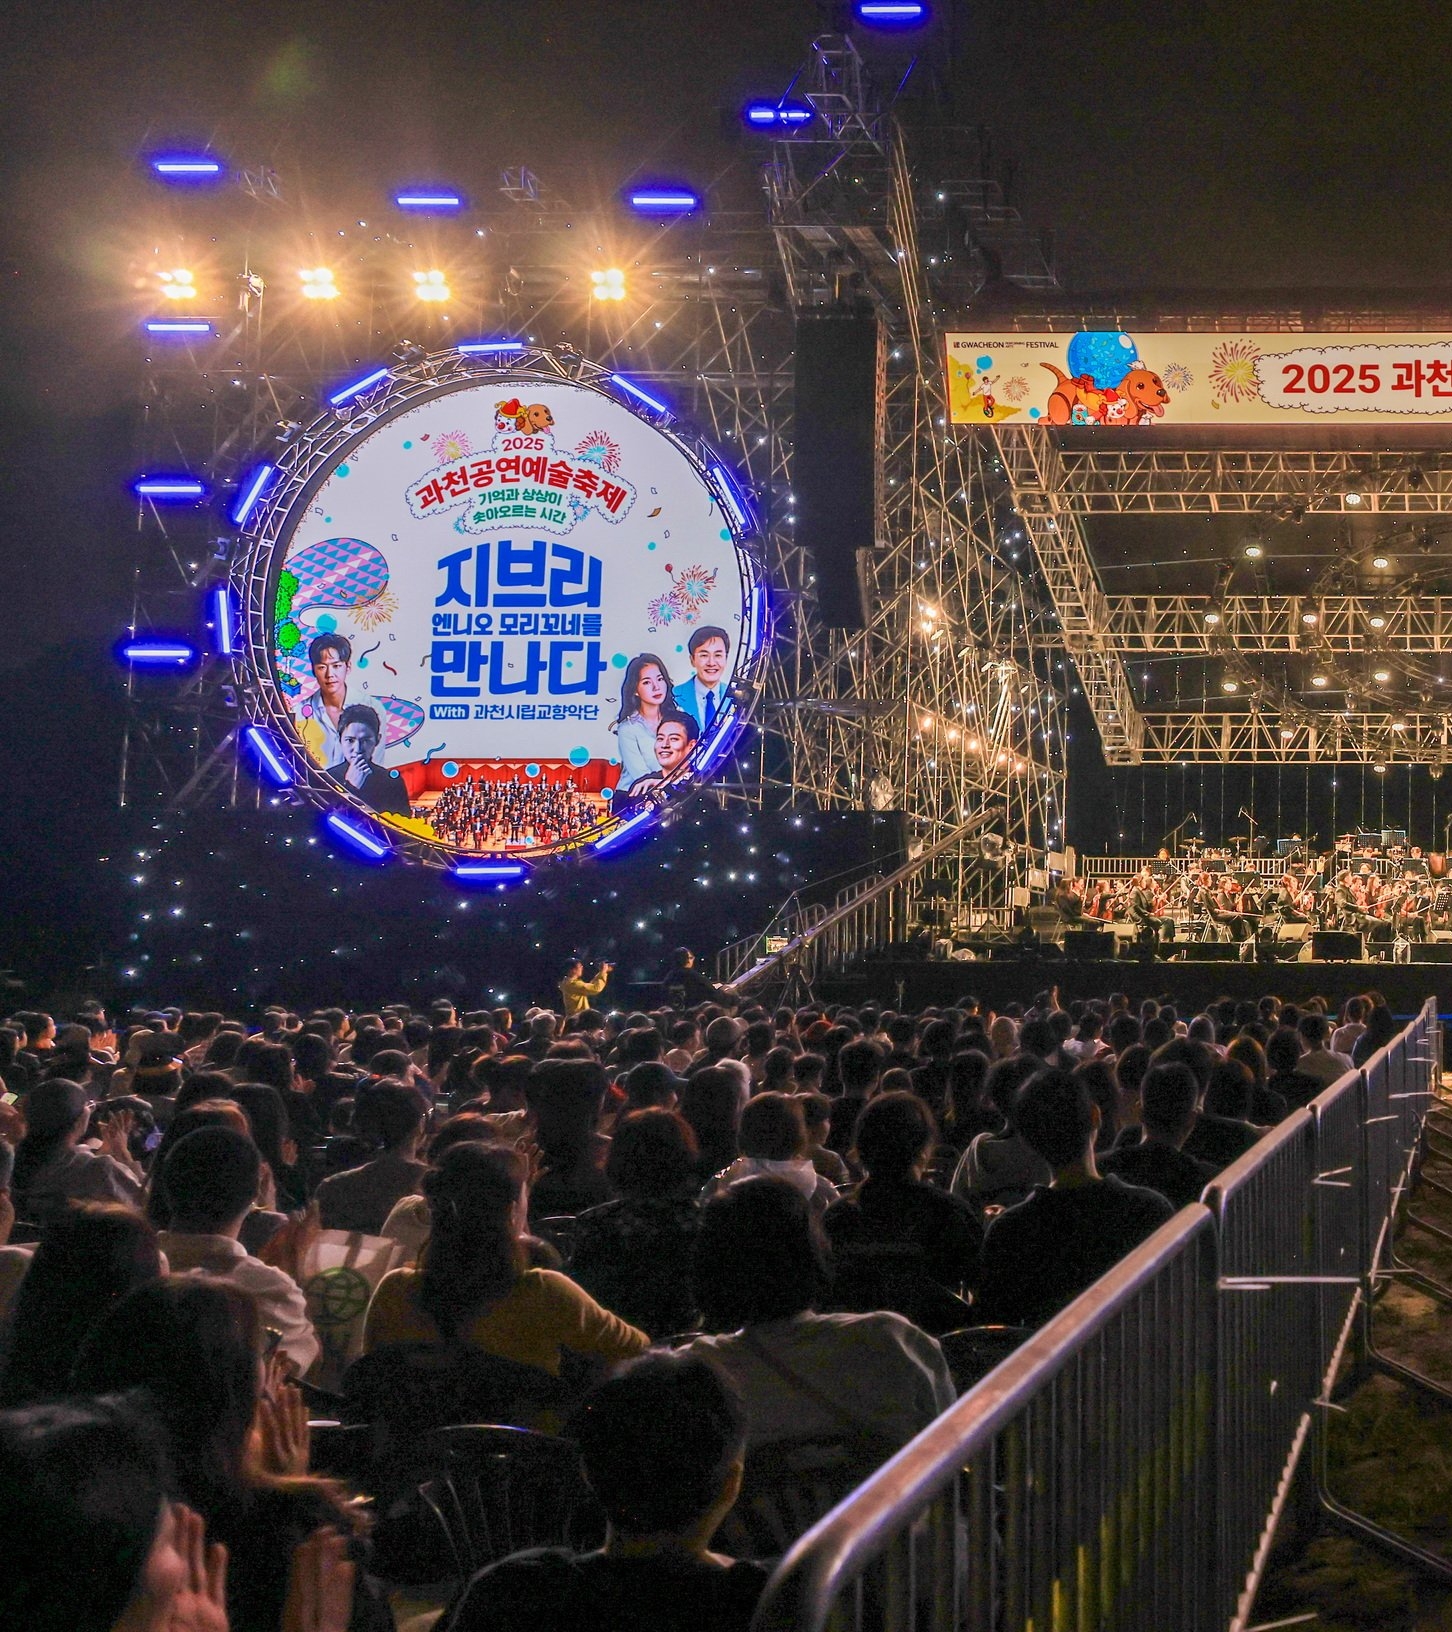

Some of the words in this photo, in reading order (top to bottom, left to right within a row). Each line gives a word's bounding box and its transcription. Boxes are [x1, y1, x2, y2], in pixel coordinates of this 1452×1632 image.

[1281, 363, 1381, 394] 2025
[501, 437, 545, 451] 2025
[415, 455, 628, 513] 과천공연예술축제
[478, 488, 520, 506] 기억과
[522, 488, 563, 506] 상상이
[472, 505, 537, 524] 솟아오르는
[540, 507, 567, 524] 시간
[435, 540, 603, 607] 지브리
[432, 613, 493, 636] 엔니오
[499, 613, 602, 636] 모리꼬네를
[431, 641, 607, 697] 만나다
[433, 705, 466, 718] With
[473, 704, 599, 720] 과천시립교향악단
